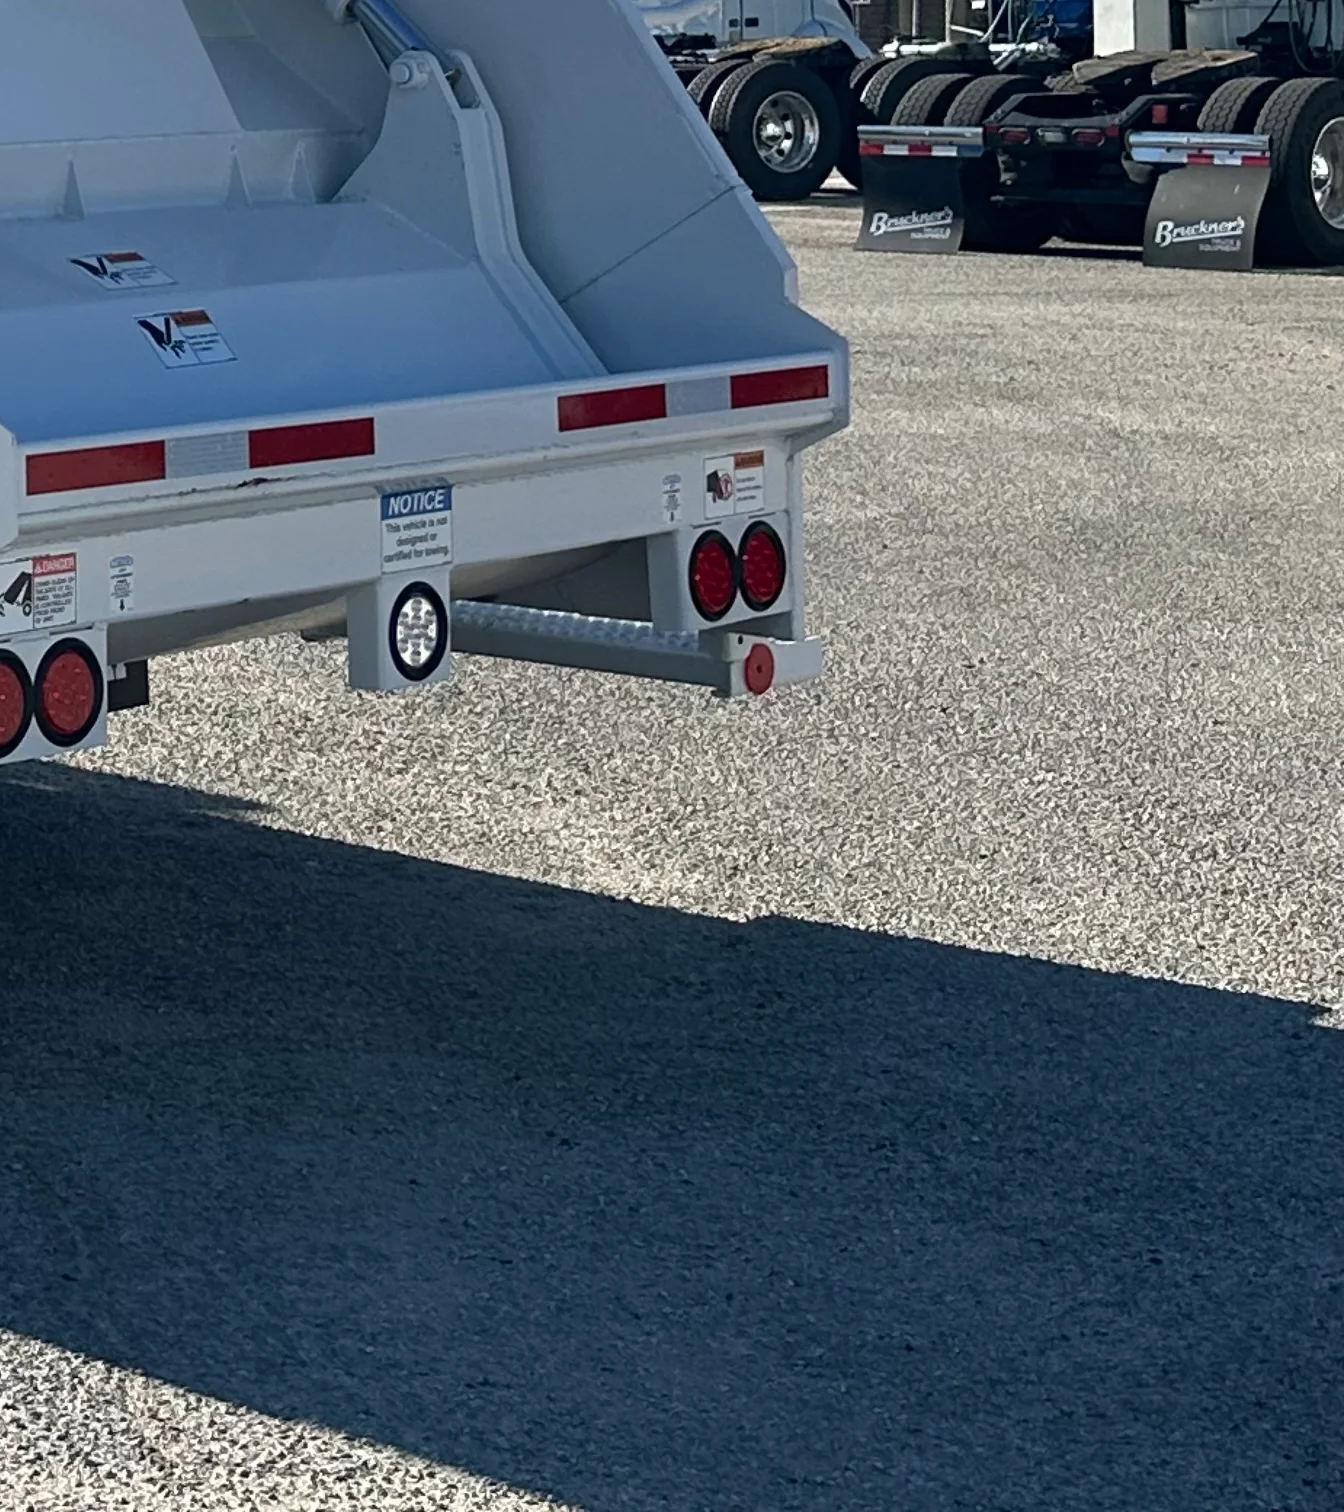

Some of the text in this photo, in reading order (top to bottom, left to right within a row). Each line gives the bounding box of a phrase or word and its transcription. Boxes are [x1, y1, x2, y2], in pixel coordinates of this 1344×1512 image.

[870, 206, 954, 236] Bruckner's
[1154, 216, 1246, 247] Bruckner's
[388, 489, 446, 516] NOTICE
[385, 522, 401, 533] This
[403, 519, 427, 531] vehicle
[436, 516, 448, 526] not
[396, 532, 438, 547] designed or
[383, 549, 412, 563] certified
[414, 548, 424, 557] for
